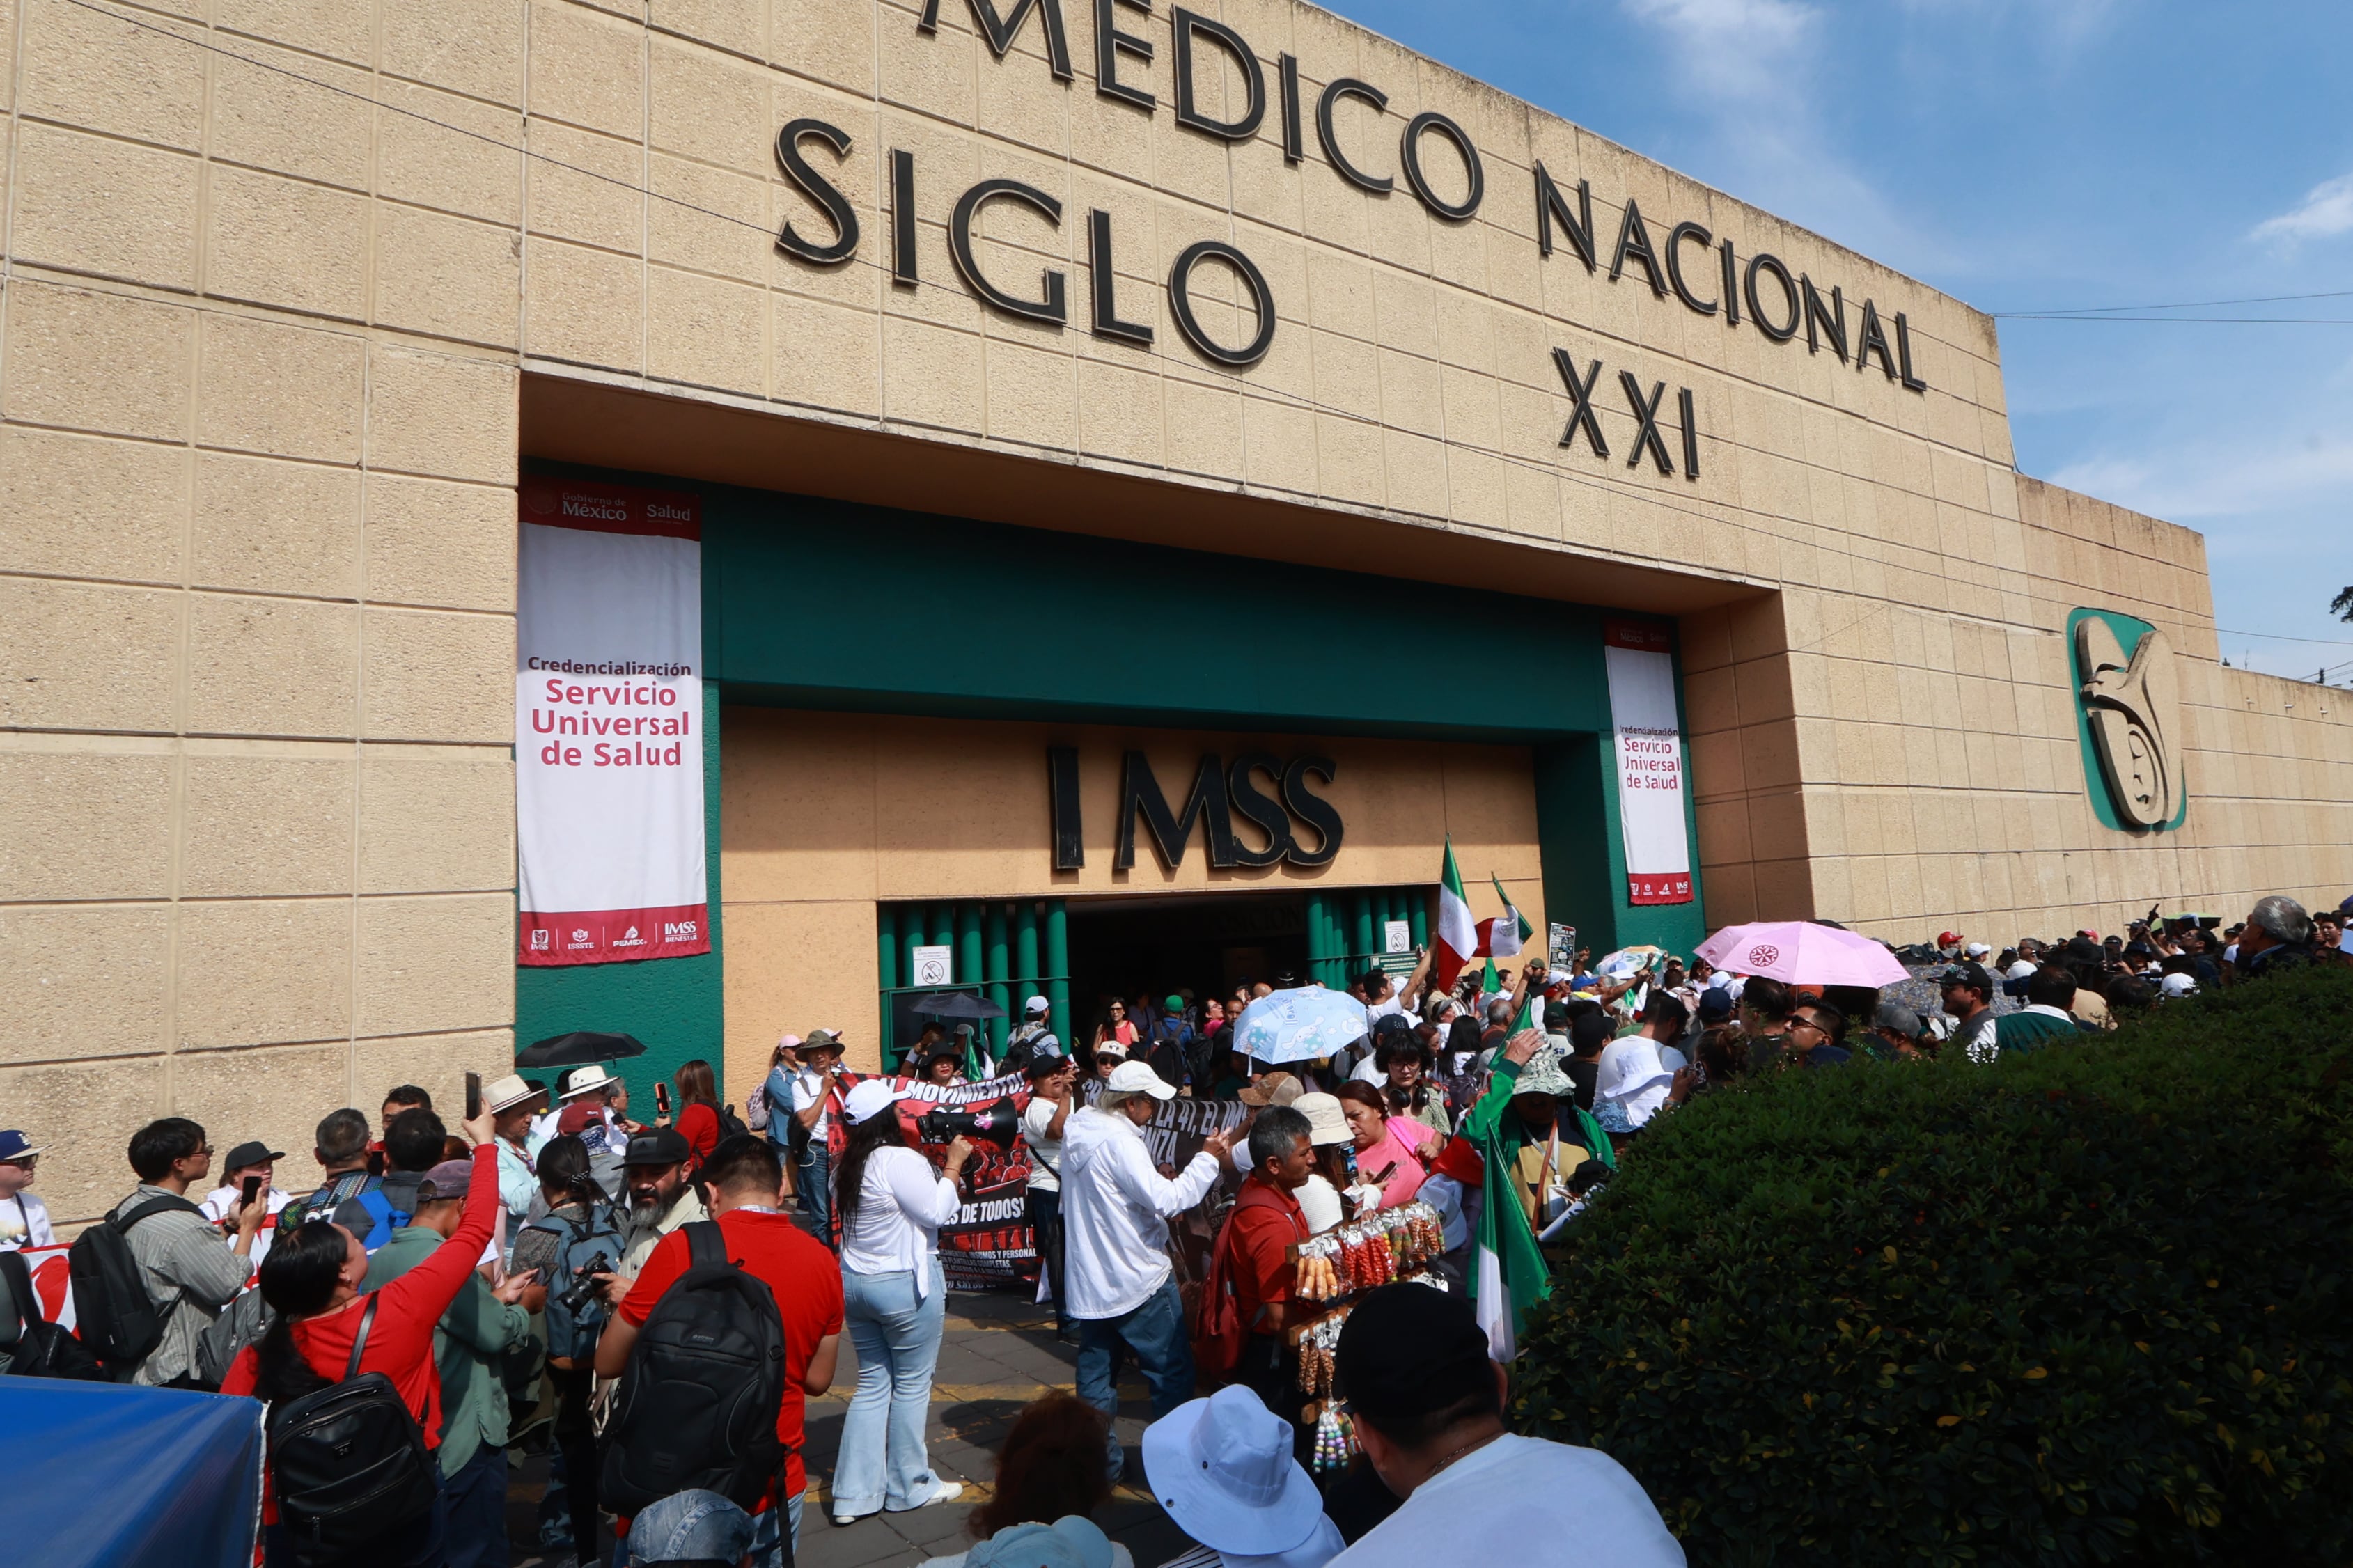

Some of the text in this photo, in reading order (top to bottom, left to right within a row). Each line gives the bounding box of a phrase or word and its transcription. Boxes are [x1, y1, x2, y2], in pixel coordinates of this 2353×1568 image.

[1534, 158, 1927, 392] NACIONAL
[775, 118, 1700, 478] SIGLO XXI
[562, 492, 627, 507] Gobierno de
[563, 501, 691, 522] México Salud
[528, 657, 691, 677] Credencialización
[546, 678, 677, 706] Servicio
[532, 709, 689, 736] Universal
[1620, 725, 1678, 737] redencialización
[541, 740, 682, 767] de Salud
[1624, 737, 1673, 754] Servicio
[1627, 774, 1678, 790] de Salud
[1049, 746, 1344, 870] IMSS
[664, 920, 697, 934] IMSS
[613, 939, 644, 947] PEMEX
[905, 1071, 1026, 1105] MOVIMIENTO!
[1155, 1100, 1176, 1129] LA
[1200, 1101, 1219, 1136] EL
[961, 1203, 979, 1224] DE
[980, 1197, 1025, 1223] TODOS!
[997, 1250, 1002, 1260] Y
[1003, 1248, 1037, 1259] PERSONAL
